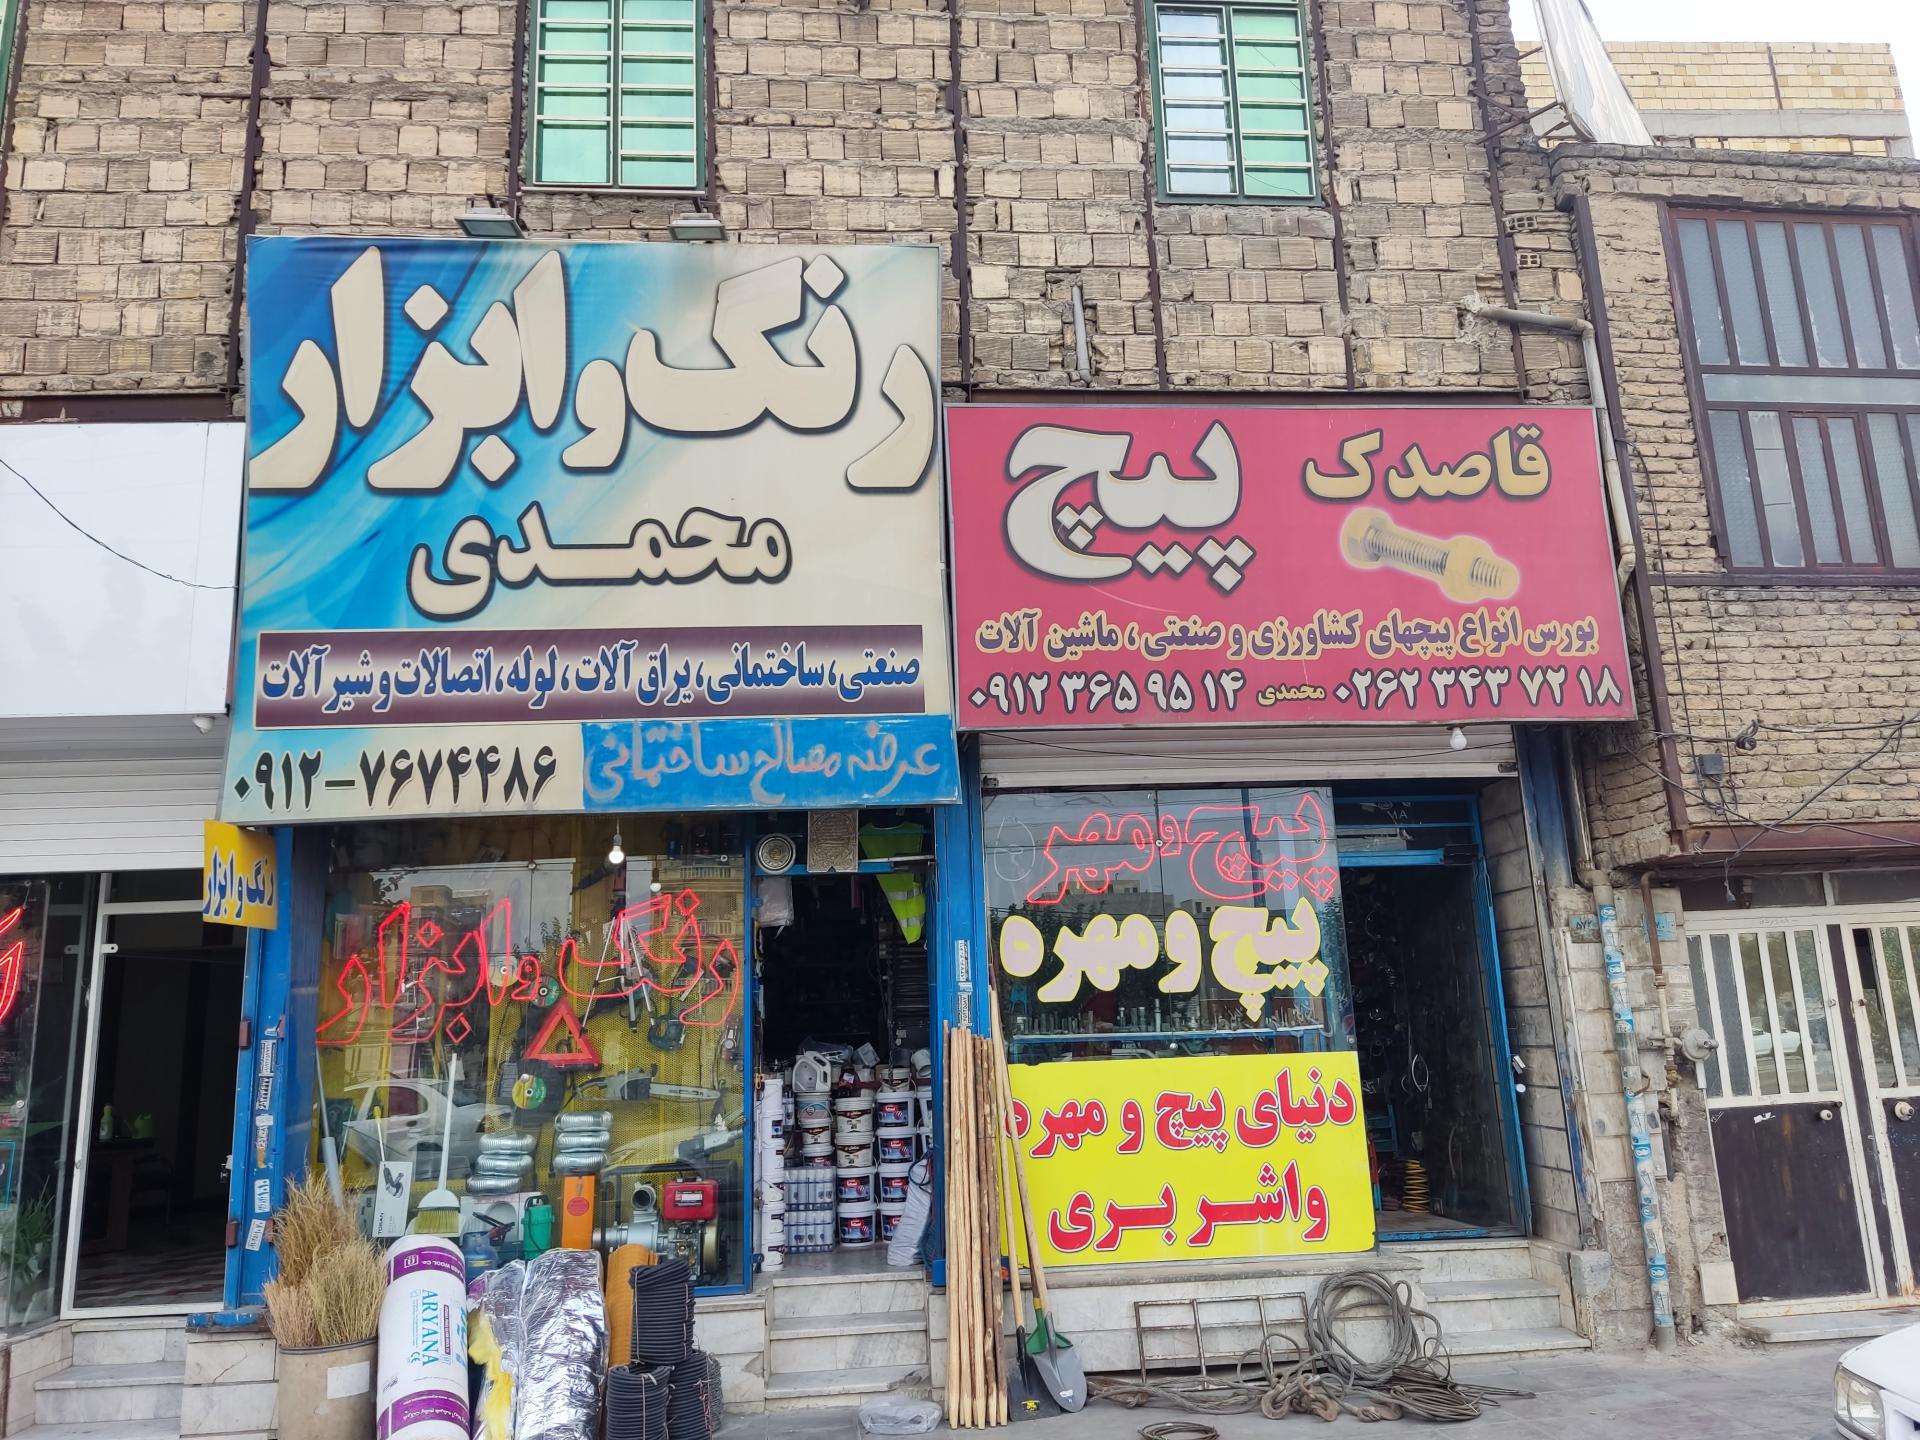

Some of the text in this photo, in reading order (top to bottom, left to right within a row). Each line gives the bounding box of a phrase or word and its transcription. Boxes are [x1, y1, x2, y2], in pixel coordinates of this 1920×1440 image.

[247, 245, 568, 490] ابزار
[562, 359, 626, 469] و
[1301, 422, 1552, 503] قاصدک
[1005, 418, 1256, 596] پیچ
[407, 501, 792, 621] محمدی
[975, 608, 1042, 652] آلات
[1044, 609, 1122, 662] ماشین
[1226, 620, 1247, 660] و
[1250, 608, 1363, 660] کشاورزی
[1369, 608, 1456, 660] پیچهای
[1458, 608, 1521, 658] انواع
[1527, 615, 1600, 658] بورس
[372, 665, 393, 711] و
[396, 646, 494, 698] اتصالات
[636, 644, 693, 704] یراق
[969, 669, 1050, 714] ۰۹۱۲
[1058, 669, 1139, 713] ۳۶۵
[1256, 684, 1326, 707] محمدی
[750, 718, 842, 804] مصالح
[1159, 813, 1183, 857] و
[1184, 794, 1340, 901] پیچ
[315, 887, 740, 1047] رنگ و ابزار
[999, 896, 1330, 1023] پیچ و مهره
[1004, 1067, 1357, 1158] دنیای پیچ و مهره
[1048, 1159, 1330, 1253] واشر بری
[421, 1289, 439, 1367] ARYANA
